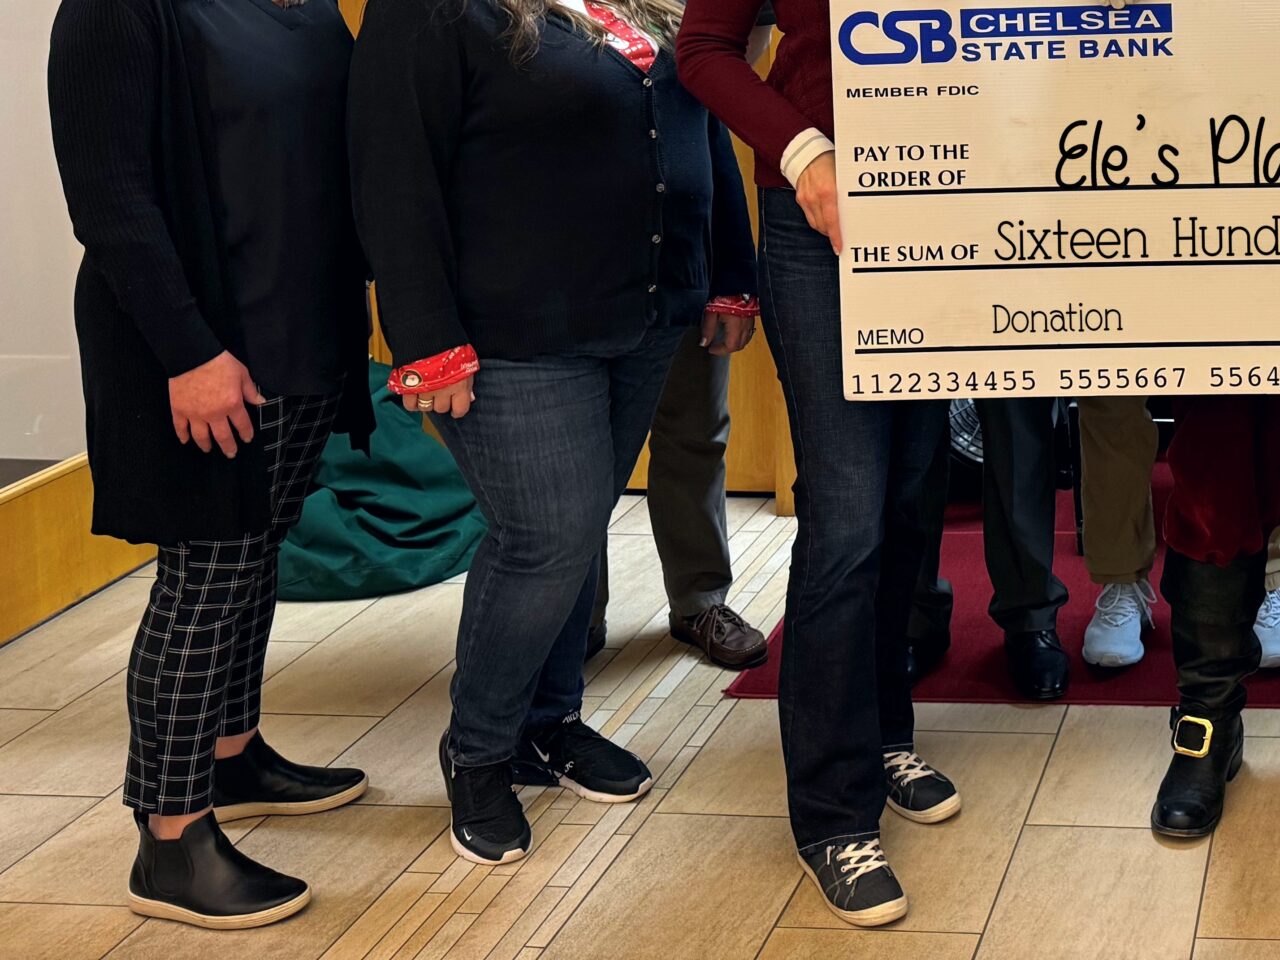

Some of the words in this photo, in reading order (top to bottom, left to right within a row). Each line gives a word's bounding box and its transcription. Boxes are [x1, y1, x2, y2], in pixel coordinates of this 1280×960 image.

[838, 9, 957, 66] CSB
[968, 9, 1161, 34] CHELSEA
[961, 41, 1067, 63] STATE
[1079, 37, 1174, 59] BANK
[846, 86, 929, 99] MEMBER
[936, 85, 980, 97] FDIC
[853, 145, 891, 163] PAY
[894, 145, 925, 162] TO
[930, 143, 970, 161] THE
[1055, 114, 1181, 188] Ele's
[857, 171, 930, 188] ORDER
[936, 169, 967, 186] OF
[850, 246, 891, 263] THE
[896, 245, 945, 263] SUM
[950, 243, 980, 261] OF
[994, 219, 1149, 262] Sixteen
[991, 302, 1124, 334] Donation
[857, 327, 925, 346] MEMO
[851, 370, 1037, 395] 1122334455
[1059, 367, 1186, 390] 5555667
